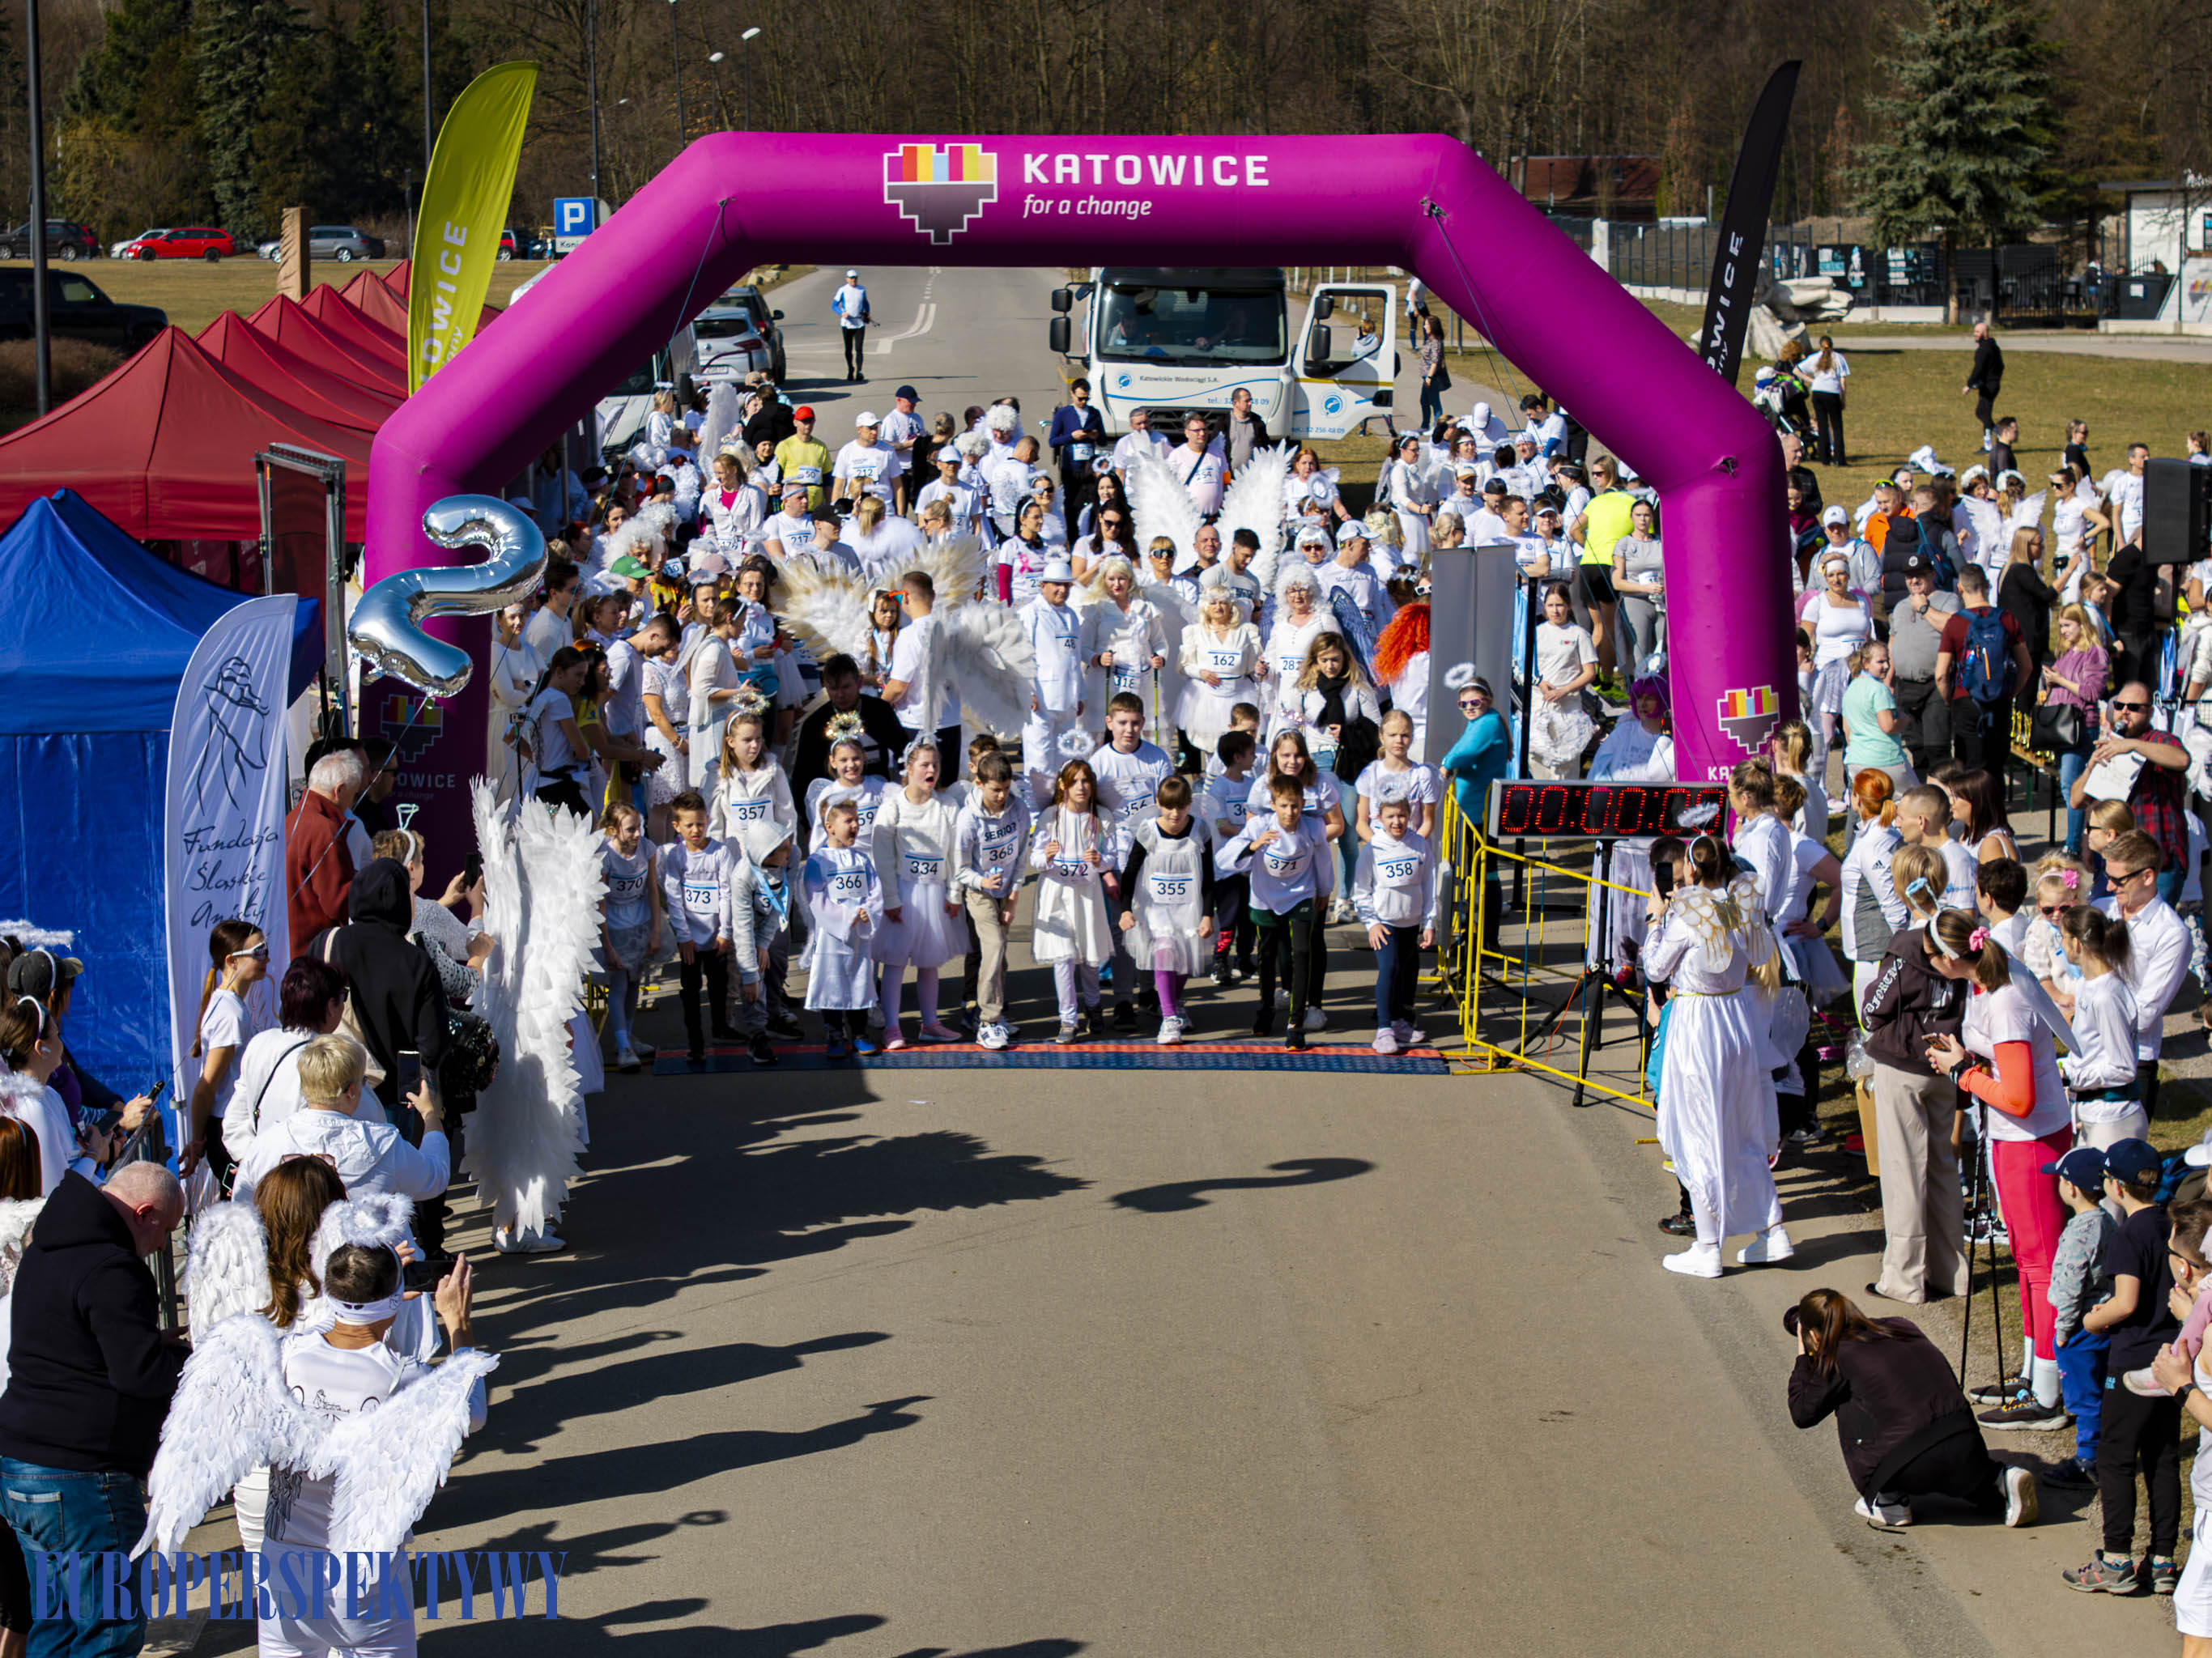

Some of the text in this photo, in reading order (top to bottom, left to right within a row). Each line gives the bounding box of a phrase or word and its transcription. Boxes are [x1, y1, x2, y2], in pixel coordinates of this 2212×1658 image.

[1023, 153, 1269, 186] KATOWICE
[1023, 193, 1152, 220] for a change
[564, 202, 585, 232] P
[1214, 655, 1235, 666] 162
[397, 772, 456, 788] OWICE
[738, 806, 766, 820] 357
[857, 810, 874, 827] 59
[989, 844, 1014, 861] 368
[910, 861, 938, 875] 334
[1060, 864, 1089, 877] 372
[1270, 859, 1297, 871] 371
[1385, 862, 1413, 878] 358
[616, 878, 643, 892] 370
[836, 875, 862, 890] 366
[1157, 882, 1186, 895] 355
[686, 890, 711, 903] 373
